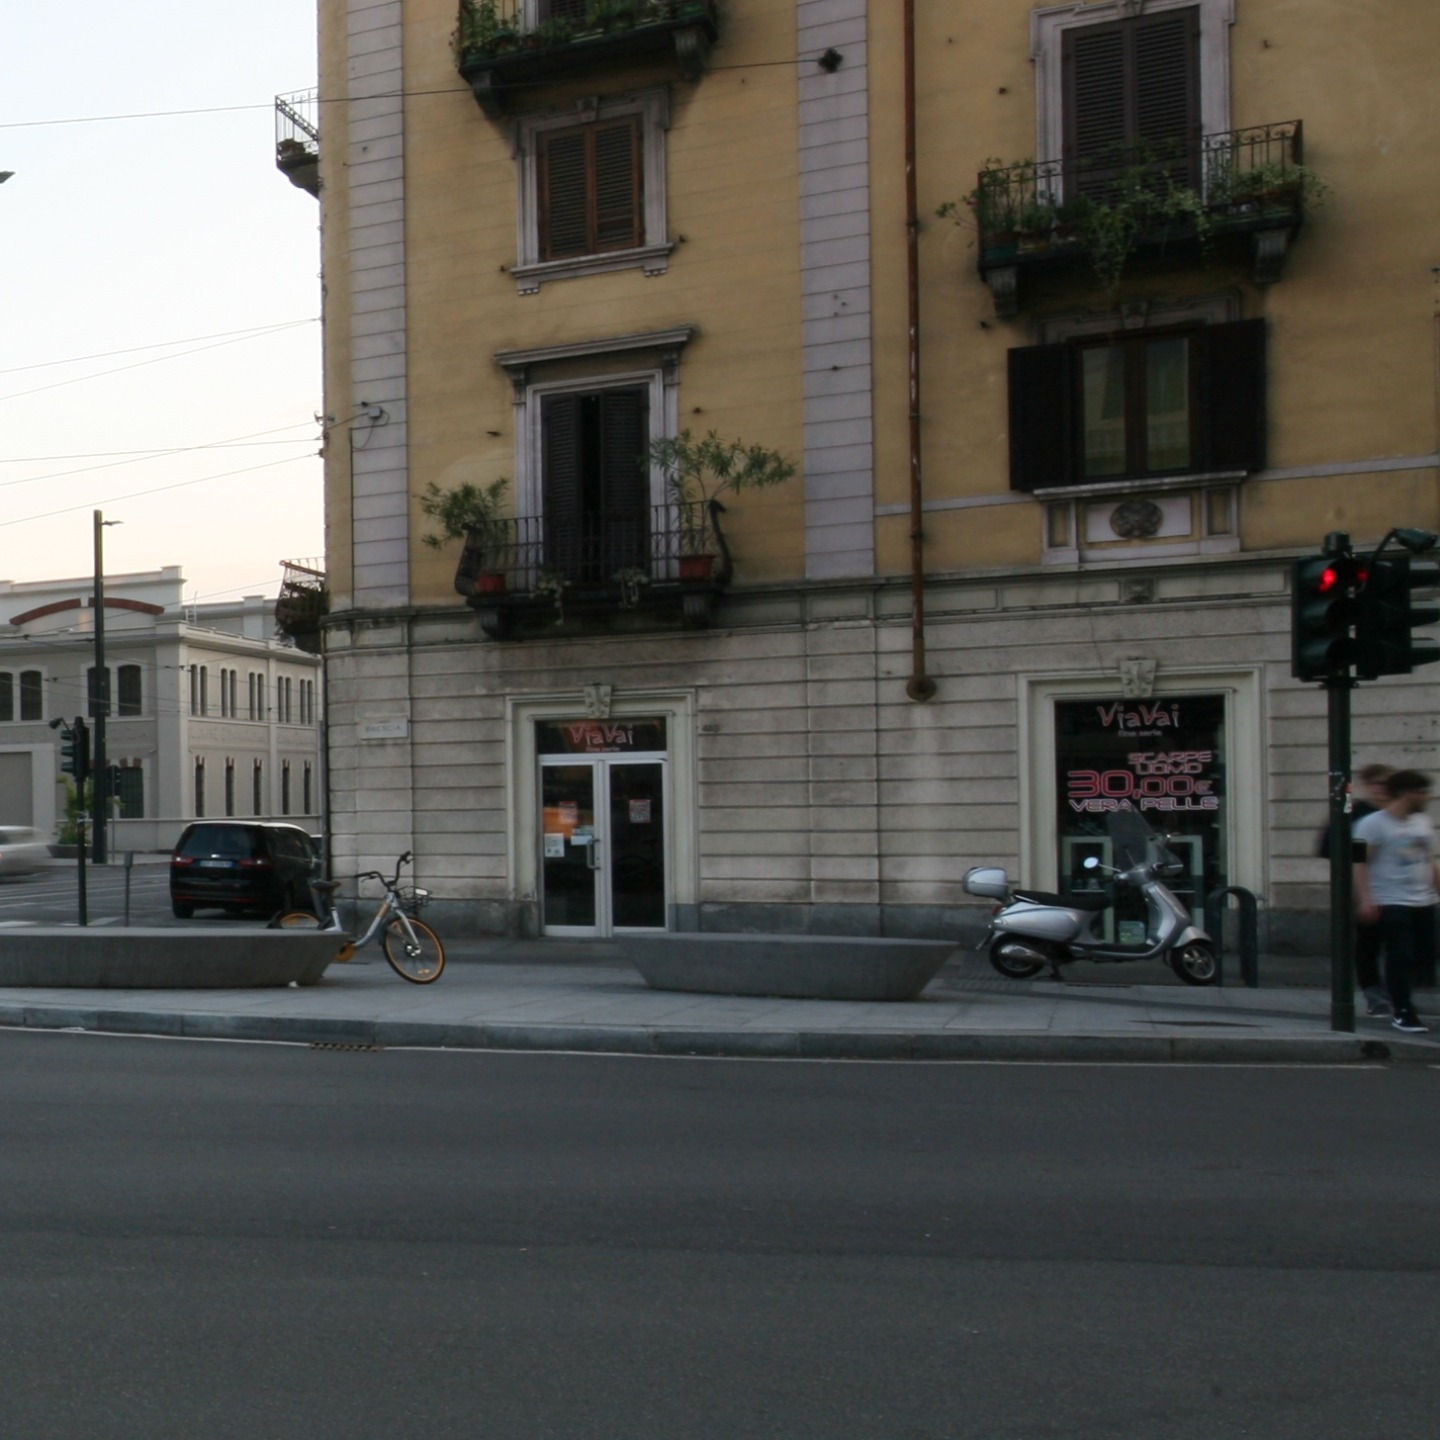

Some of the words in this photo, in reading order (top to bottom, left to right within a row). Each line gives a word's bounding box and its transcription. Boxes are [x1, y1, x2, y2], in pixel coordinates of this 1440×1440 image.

[1096, 700, 1180, 728] ViaVai
[568, 721, 633, 745] ViaVai
[1127, 750, 1213, 764] SCARPE
[1135, 762, 1203, 775] UOMO
[1066, 769, 1214, 799] 30,00€
[1068, 798, 1137, 812] VERA
[1140, 796, 1220, 811] PELLE
